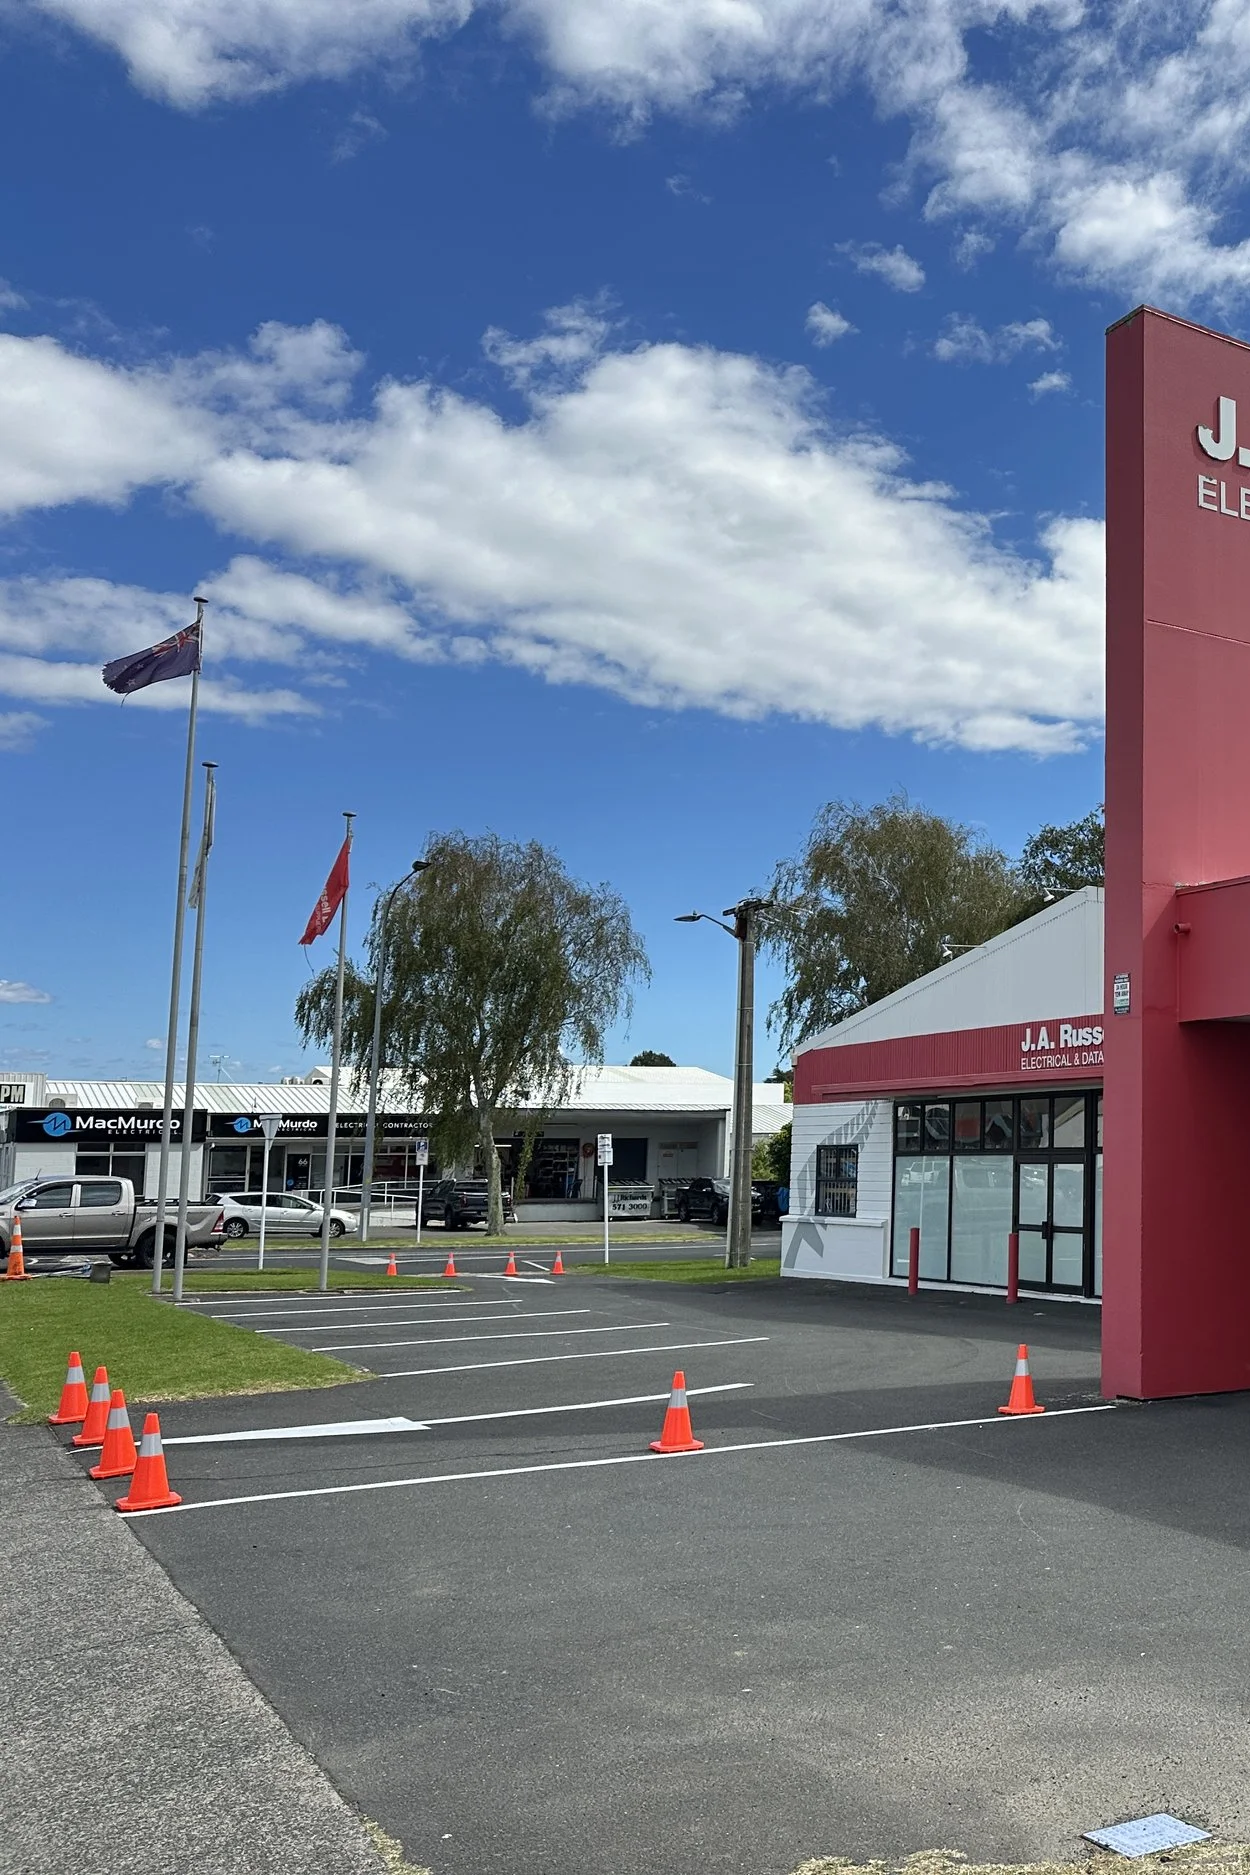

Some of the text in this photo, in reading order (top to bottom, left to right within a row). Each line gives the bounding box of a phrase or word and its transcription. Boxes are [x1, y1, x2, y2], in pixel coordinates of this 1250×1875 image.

[321, 889, 331, 914] ssell
[1060, 1024, 1104, 1048] Russ
[1021, 1051, 1104, 1070] ELECTRICAL & DATA
[253, 1119, 318, 1129] MMurdo
[612, 1203, 626, 1211] 571
